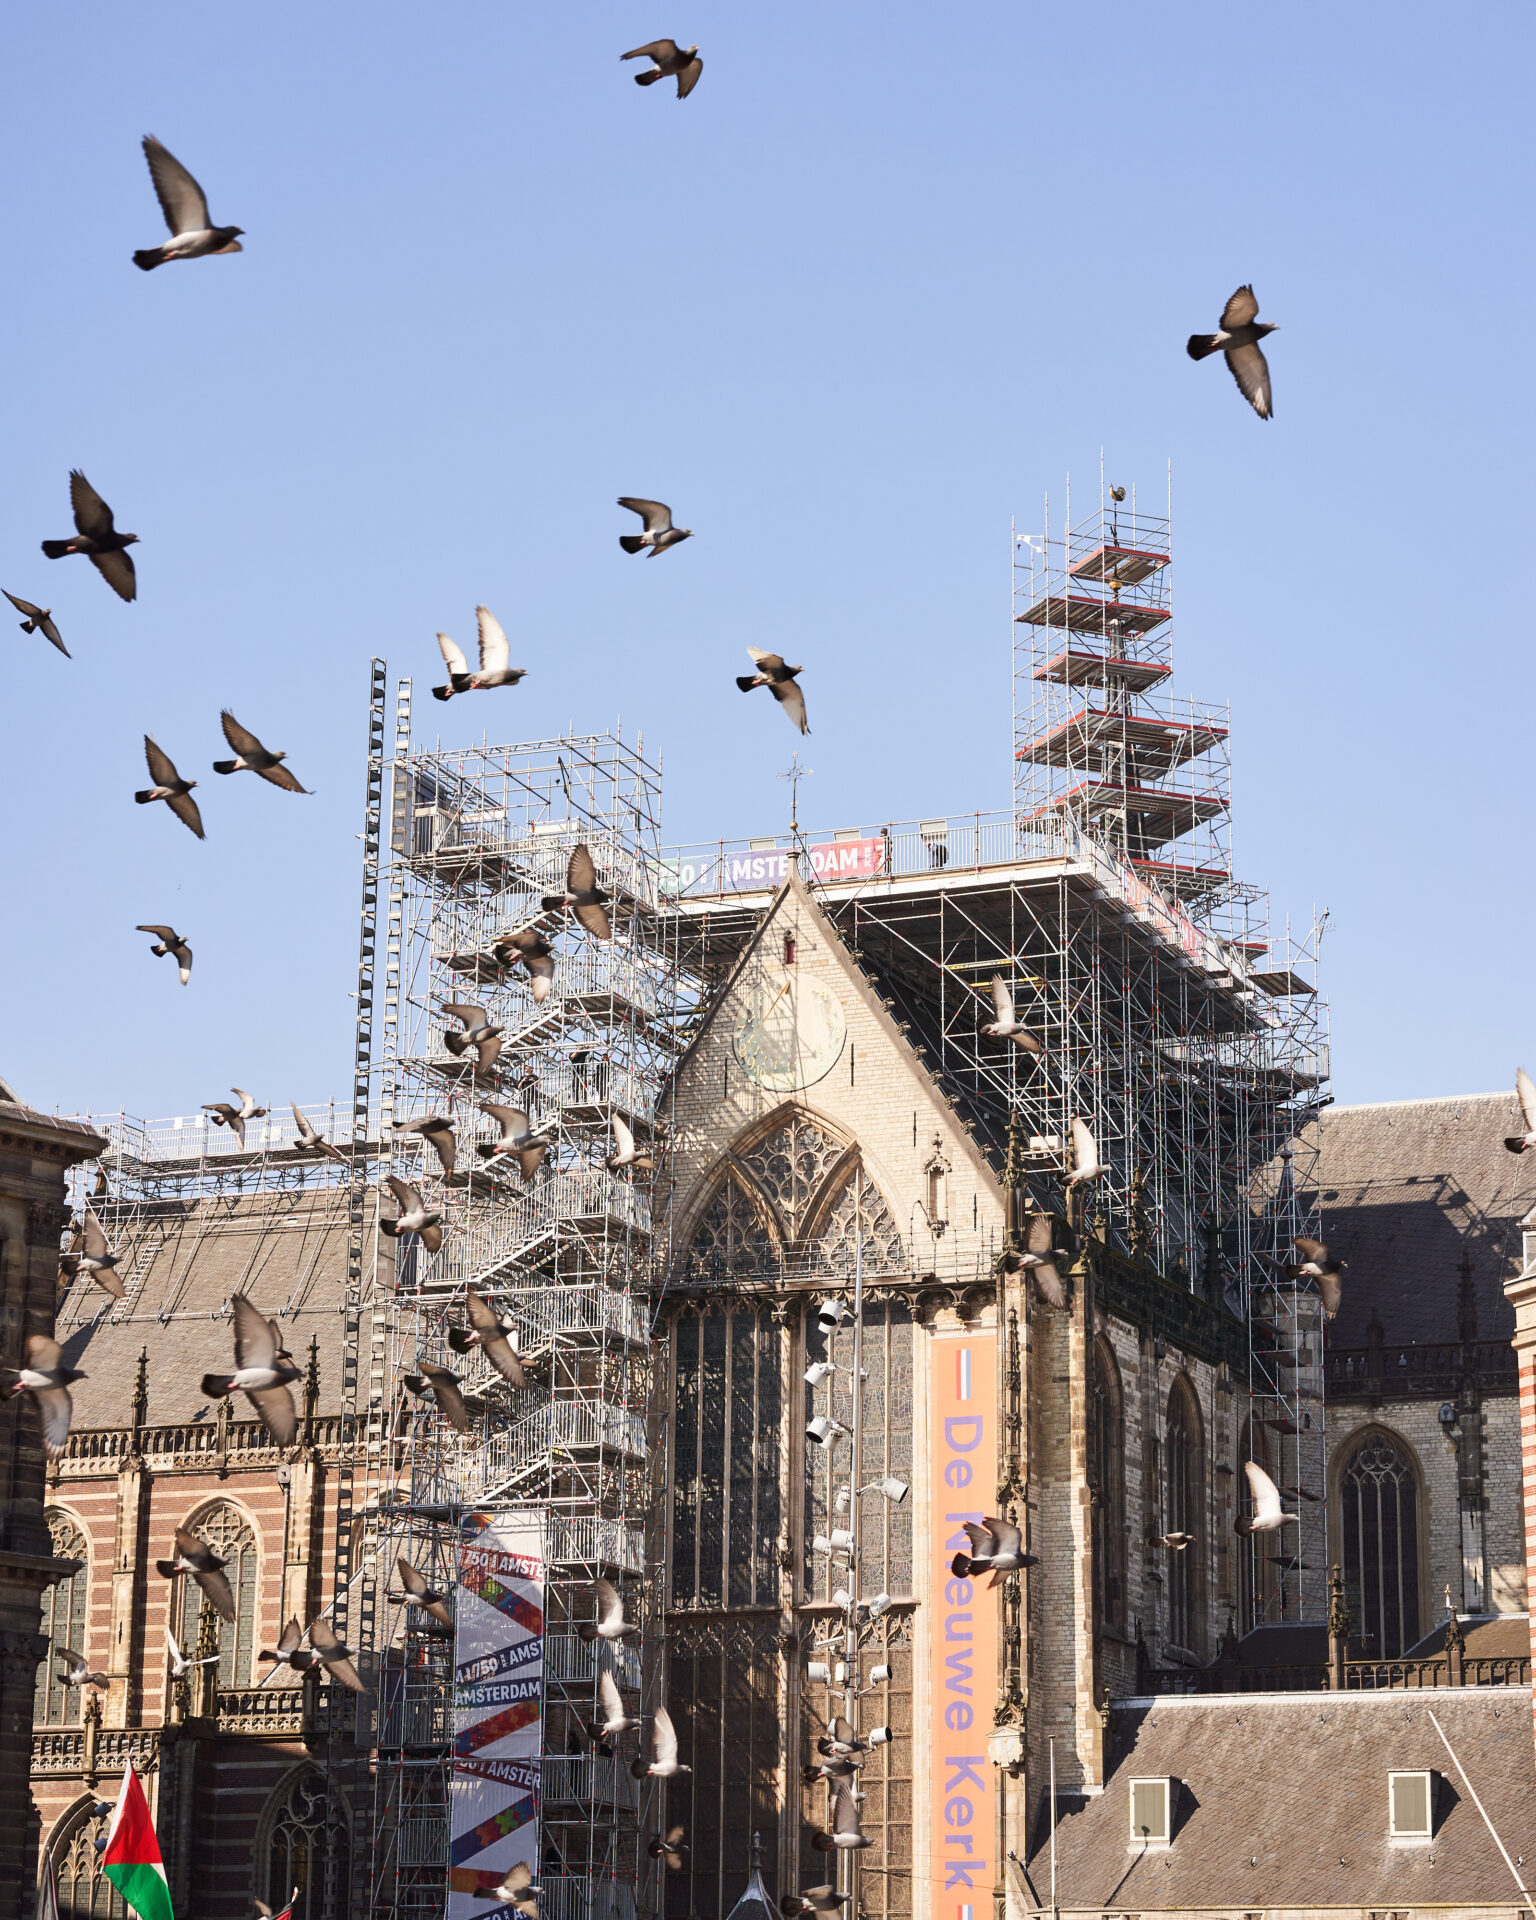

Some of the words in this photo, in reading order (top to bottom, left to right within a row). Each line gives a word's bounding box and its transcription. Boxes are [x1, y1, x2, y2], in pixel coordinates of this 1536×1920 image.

[944, 1415, 983, 1488] De
[464, 1550, 489, 1567] 750
[944, 1511, 984, 1732] Neuwe
[455, 1681, 541, 1707] AMSTERDAM
[944, 1756, 986, 1892] Kerk
